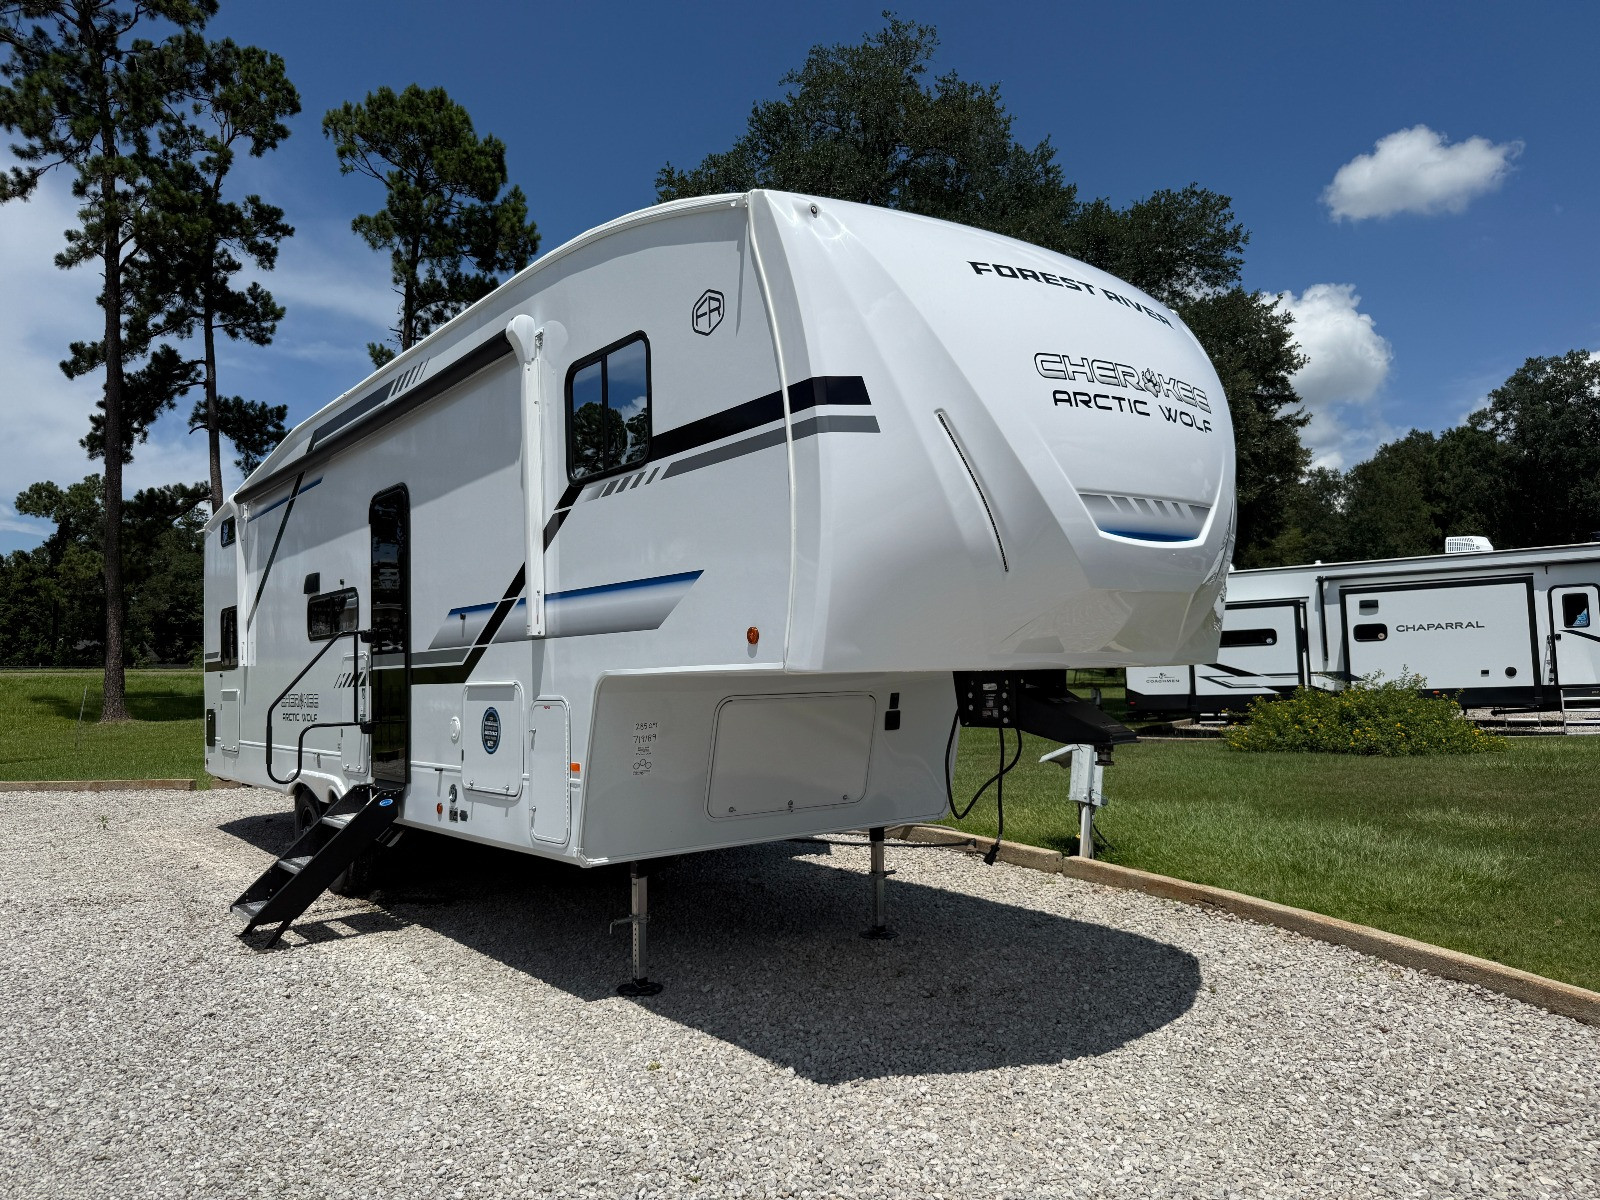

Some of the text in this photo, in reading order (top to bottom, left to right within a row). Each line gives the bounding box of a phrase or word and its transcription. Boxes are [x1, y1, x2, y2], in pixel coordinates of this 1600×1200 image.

[967, 261, 1175, 329] FOREST RIVER
[1052, 390, 1212, 433] ARCTIC WOLF
[1396, 621, 1485, 632] CHAPARRAL
[282, 712, 318, 722] ARCTIC WOLF
